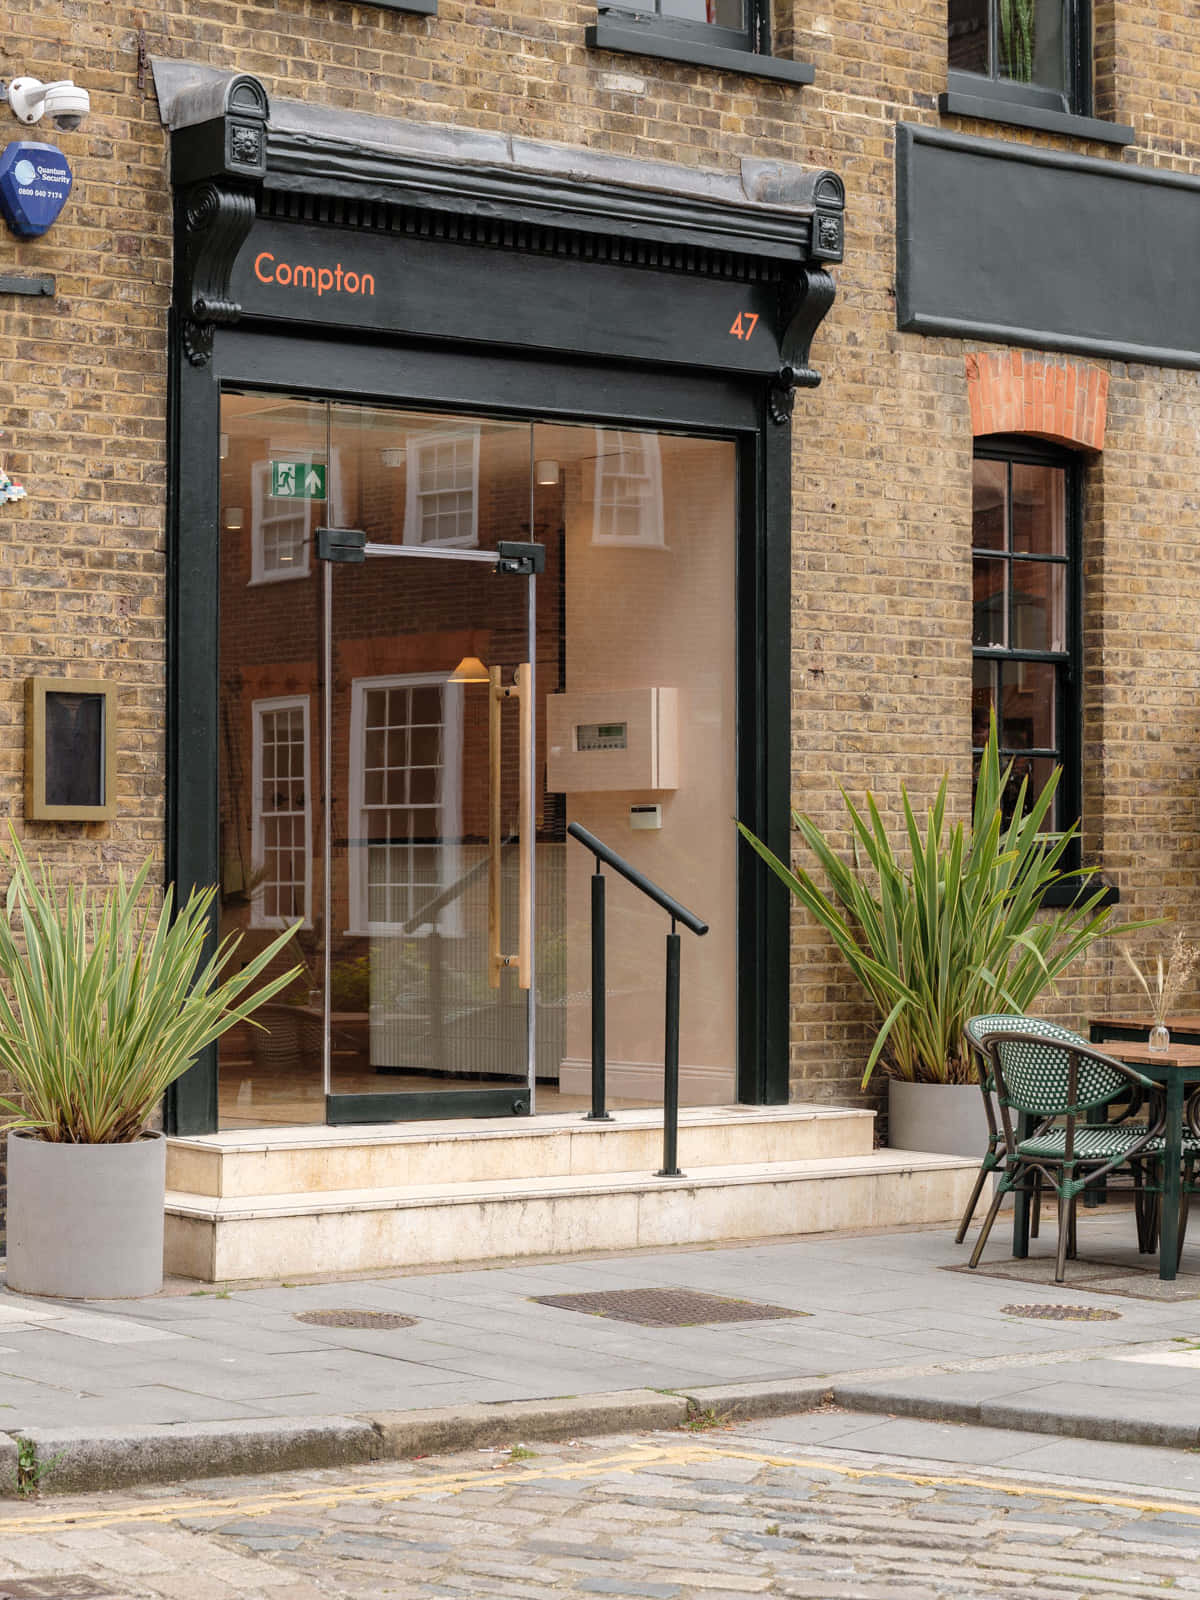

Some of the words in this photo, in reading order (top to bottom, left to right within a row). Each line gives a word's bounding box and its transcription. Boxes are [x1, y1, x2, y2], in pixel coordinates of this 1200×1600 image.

[37, 166, 66, 176] Quantum
[41, 173, 71, 185] Security
[18, 187, 34, 197] 0800
[254, 252, 375, 296] Compton
[729, 311, 760, 341] 47
